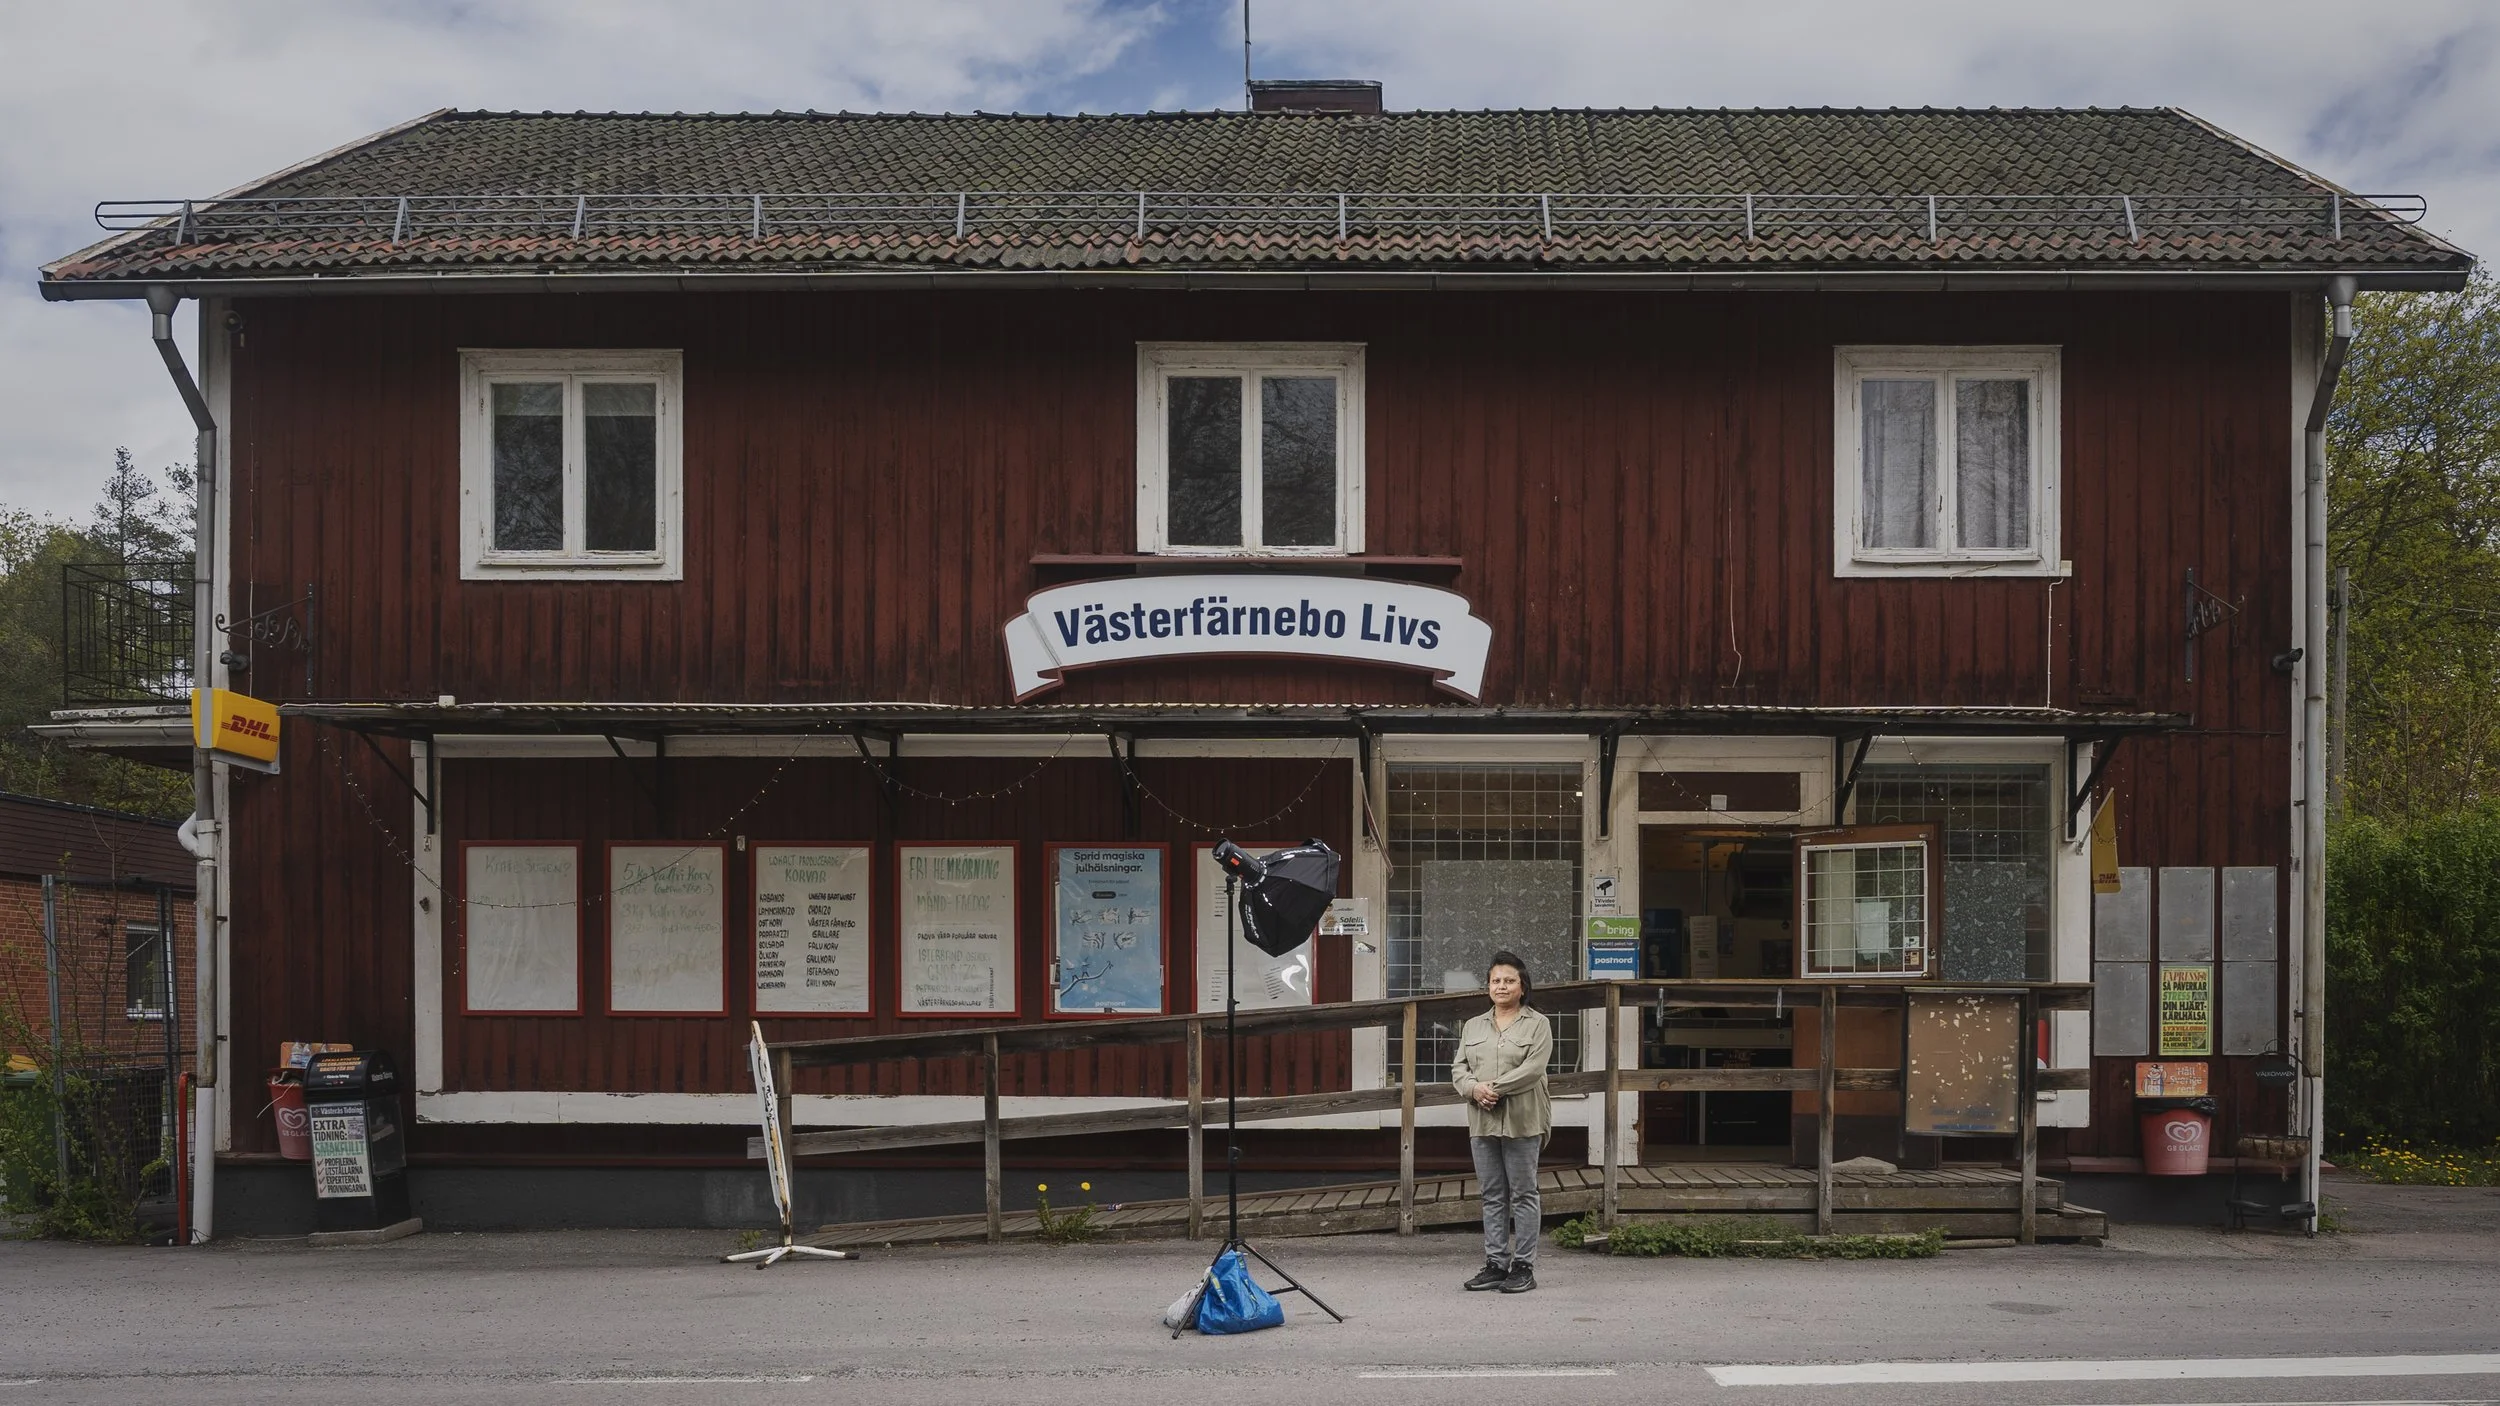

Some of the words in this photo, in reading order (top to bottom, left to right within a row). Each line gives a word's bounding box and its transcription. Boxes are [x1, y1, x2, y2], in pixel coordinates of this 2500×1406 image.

[1054, 596, 1346, 647] Västerfärnebo
[1361, 603, 1441, 650] Livs
[229, 714, 271, 741] DHL
[1074, 851, 1099, 862] Sprid
[1102, 851, 1145, 862] magiska
[909, 856, 928, 880] FRI
[1075, 863, 1143, 874] julhälsningar.
[785, 868, 827, 884] KORVAR
[758, 930, 790, 939] PAPARAZZI
[1606, 925, 1635, 936] bring
[1594, 957, 1633, 965] postnord
[2162, 981, 2171, 991] SÅ
[2173, 981, 2207, 991] PÅVERKAR
[2162, 992, 2191, 1001] STRESS
[2162, 1001, 2177, 1011] DIN
[2179, 1001, 2207, 1011] HJÄRT-
[2162, 1010, 2207, 1021] KÄRLHÄLSA
[2176, 1067, 2196, 1076] Håll
[2169, 1076, 2203, 1086] Sverige
[320, 1107, 344, 1115] Västerås
[344, 1106, 364, 1114] Tidning
[313, 1119, 346, 1131] EXTRA
[313, 1131, 348, 1141] TIDNING:
[314, 1141, 365, 1157] SMAKFULLT
[324, 1157, 358, 1167] PROFILERNA
[325, 1166, 363, 1176] UTSTÄLLARNA
[326, 1175, 360, 1184] EXPERTERNA
[327, 1184, 367, 1194] PROVNINGARNA
